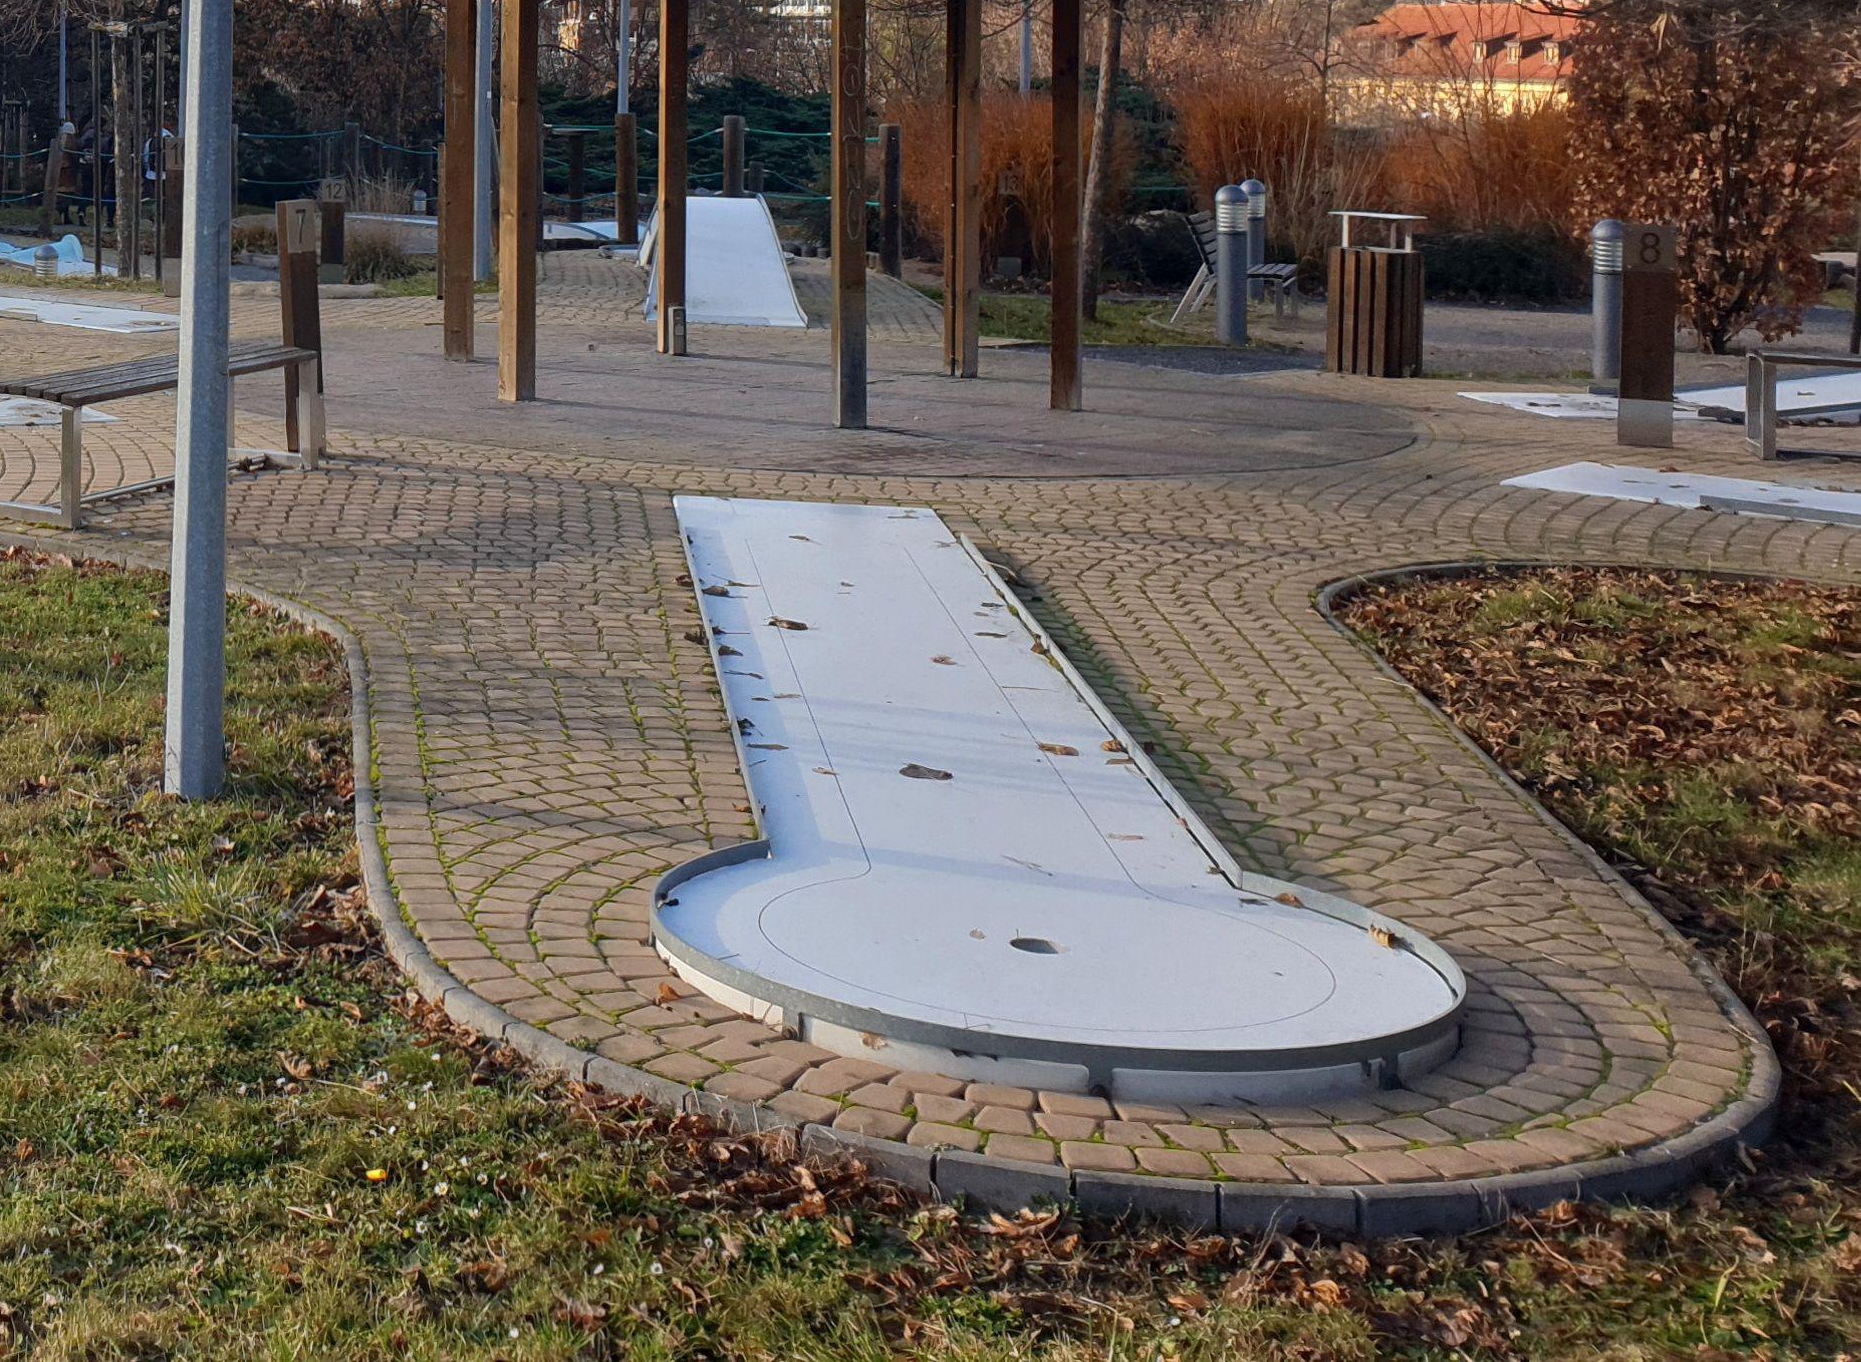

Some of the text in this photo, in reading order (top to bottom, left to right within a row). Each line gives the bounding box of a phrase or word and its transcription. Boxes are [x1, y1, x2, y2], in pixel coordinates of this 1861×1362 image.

[326, 182, 342, 199] 12
[295, 209, 307, 244] 7
[1640, 232, 1660, 264] 8
